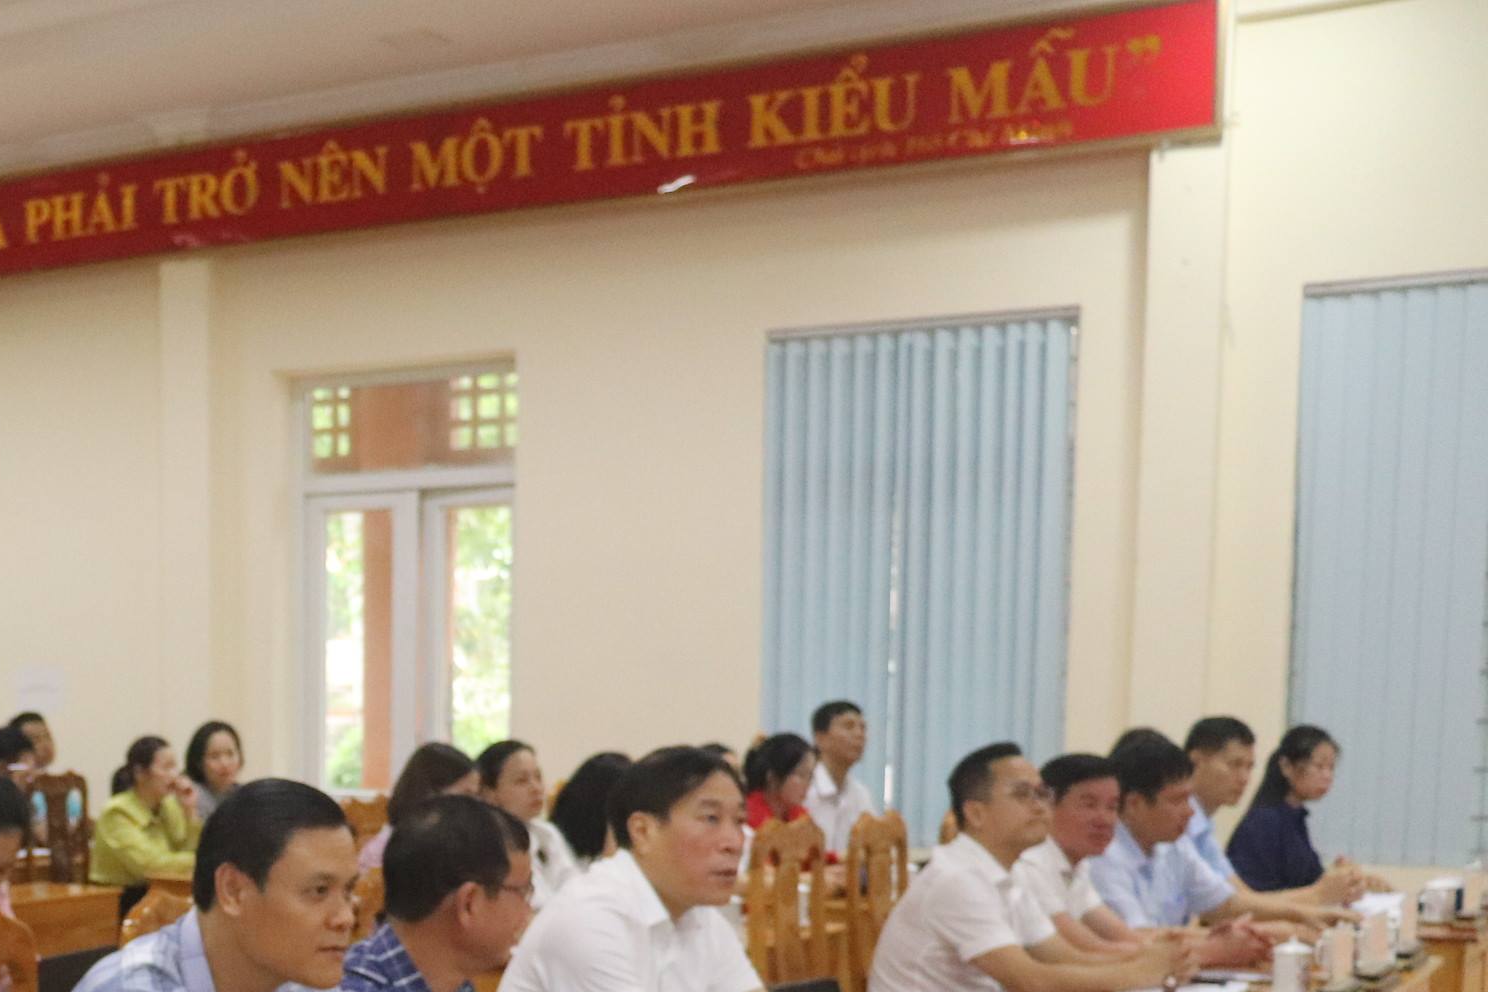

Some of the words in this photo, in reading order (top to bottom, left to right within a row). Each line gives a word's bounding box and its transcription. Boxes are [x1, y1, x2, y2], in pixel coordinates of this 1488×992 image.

[24, 171, 139, 243] PHẢI
[278, 138, 390, 209] NÊN
[410, 117, 544, 194] MỘT
[564, 94, 722, 171] TỈNH
[747, 53, 920, 148] KIỂU
